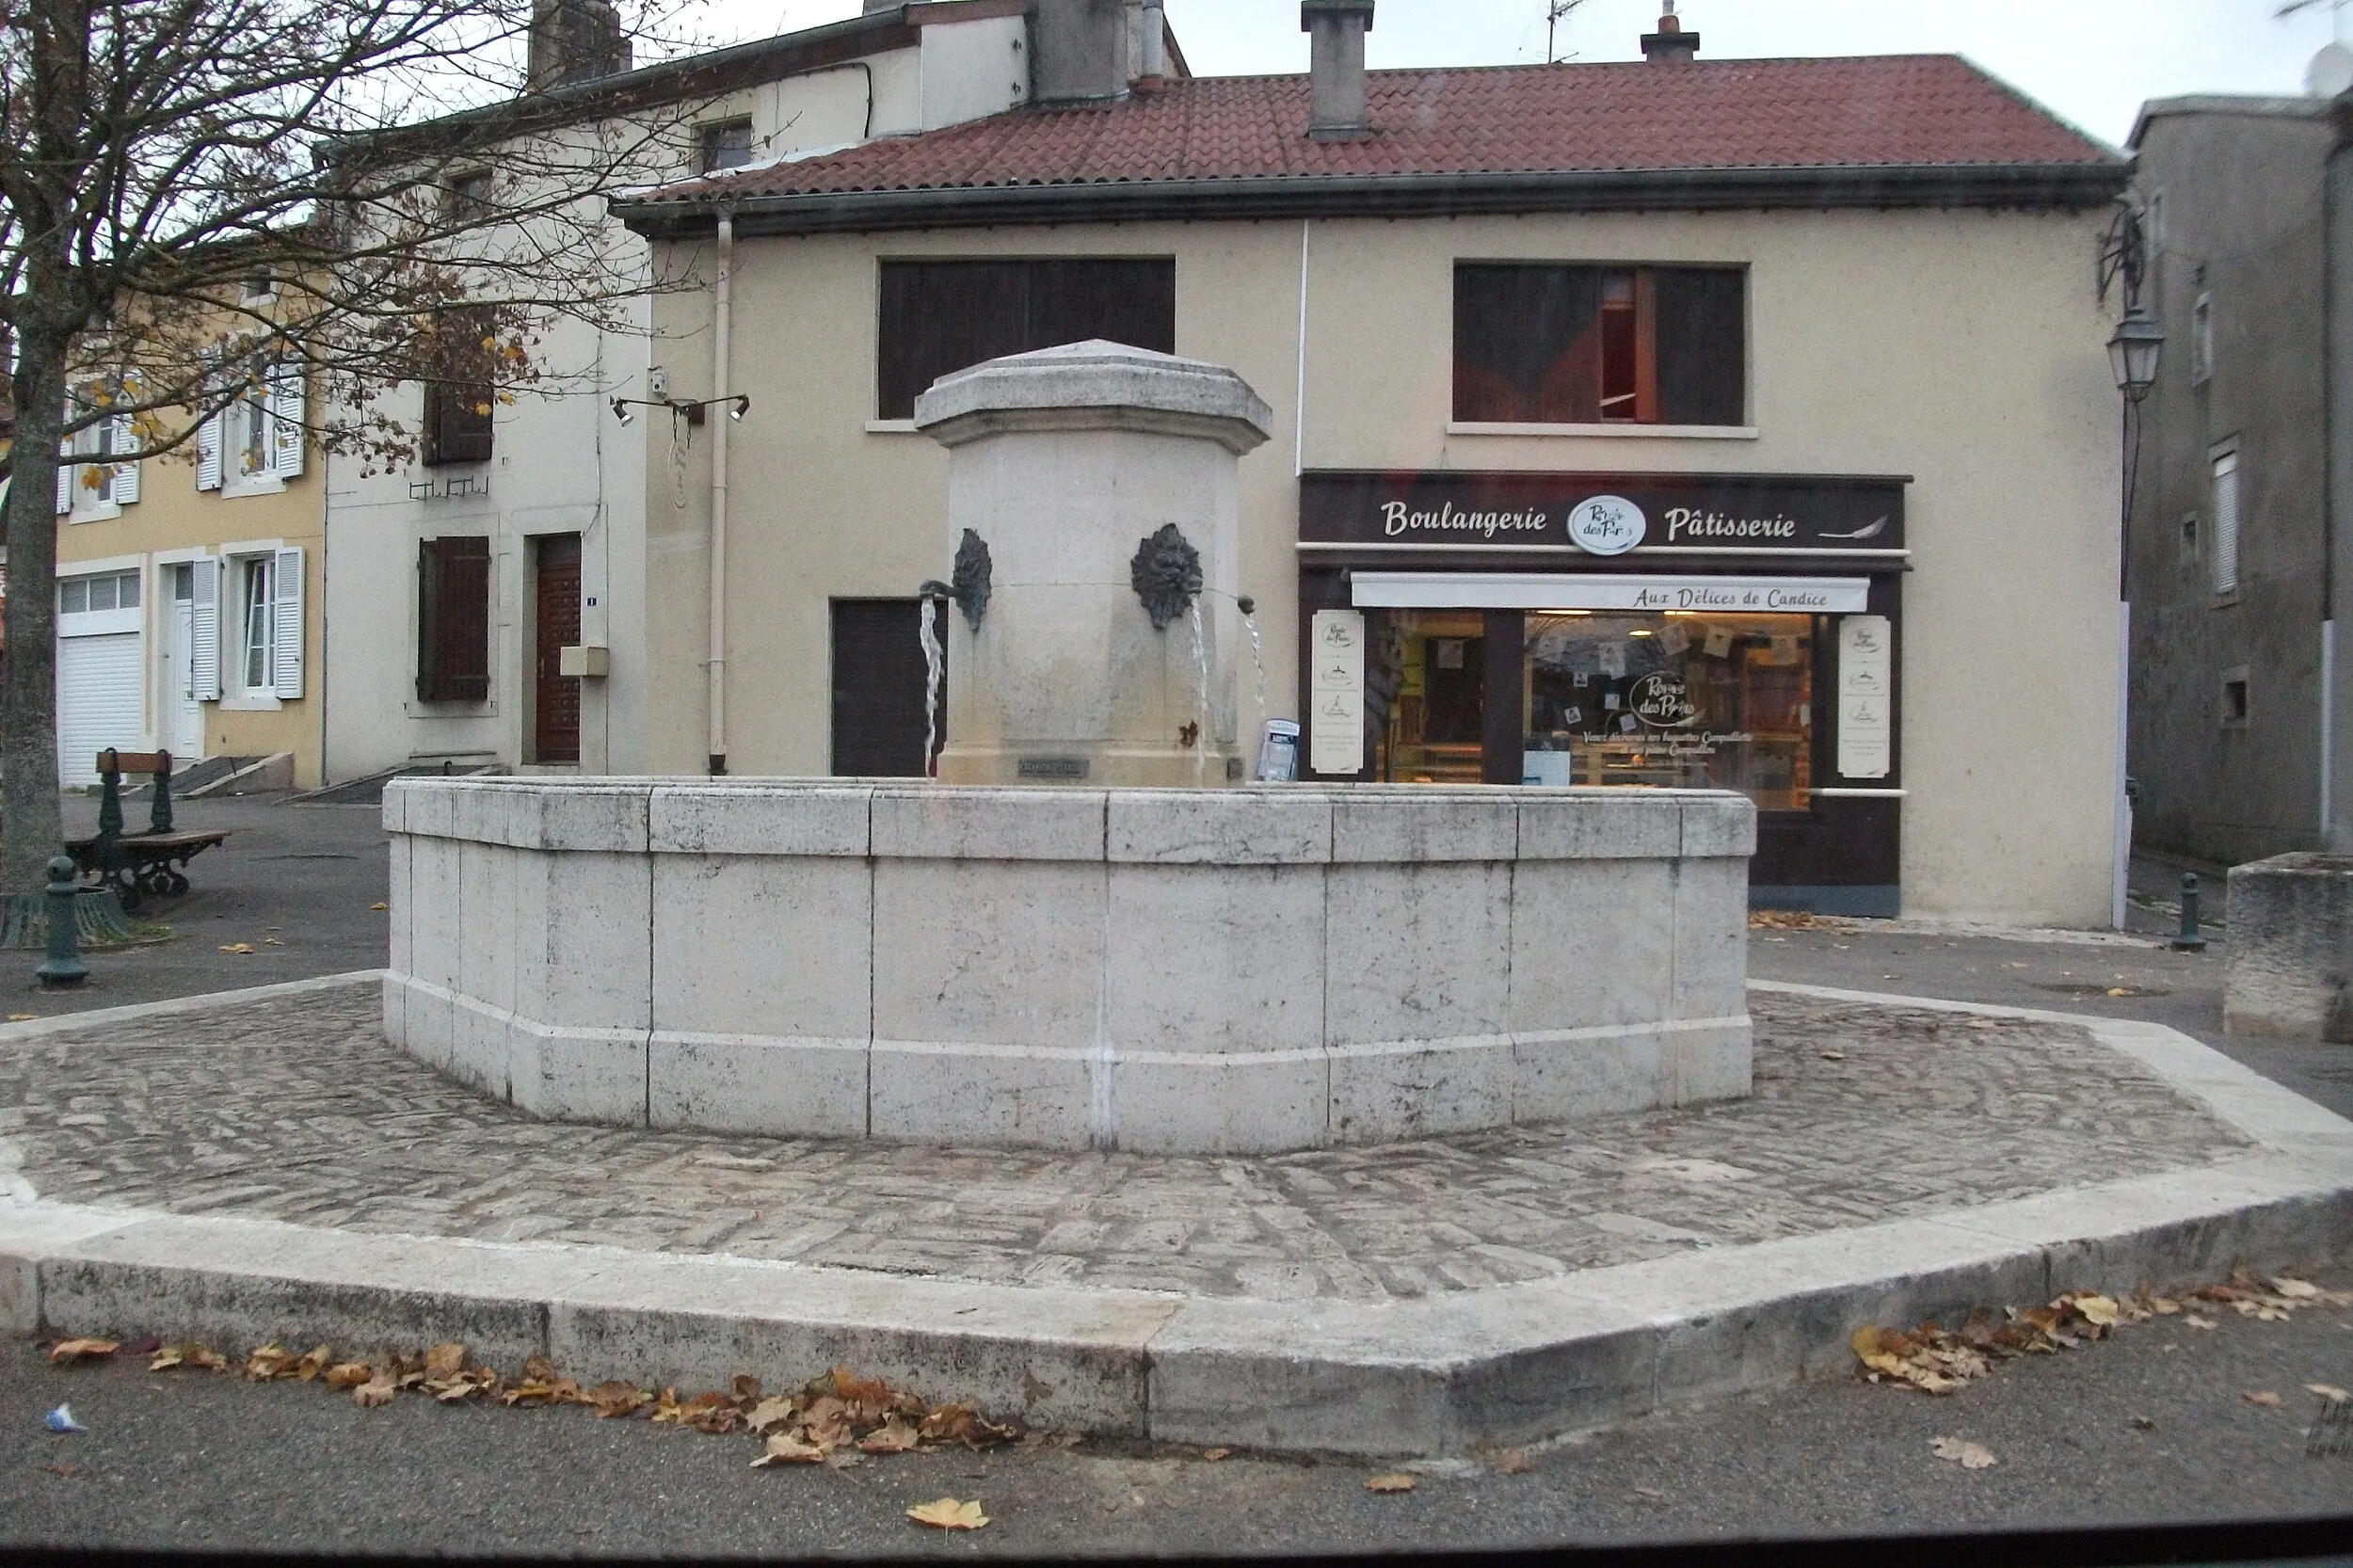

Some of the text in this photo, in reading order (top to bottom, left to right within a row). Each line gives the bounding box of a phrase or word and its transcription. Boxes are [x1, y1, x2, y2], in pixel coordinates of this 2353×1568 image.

[1380, 501, 1547, 538] Boulangerie
[1664, 507, 1797, 542] Pâtisserie
[1633, 588, 1827, 608] Aux Délices de Candice
